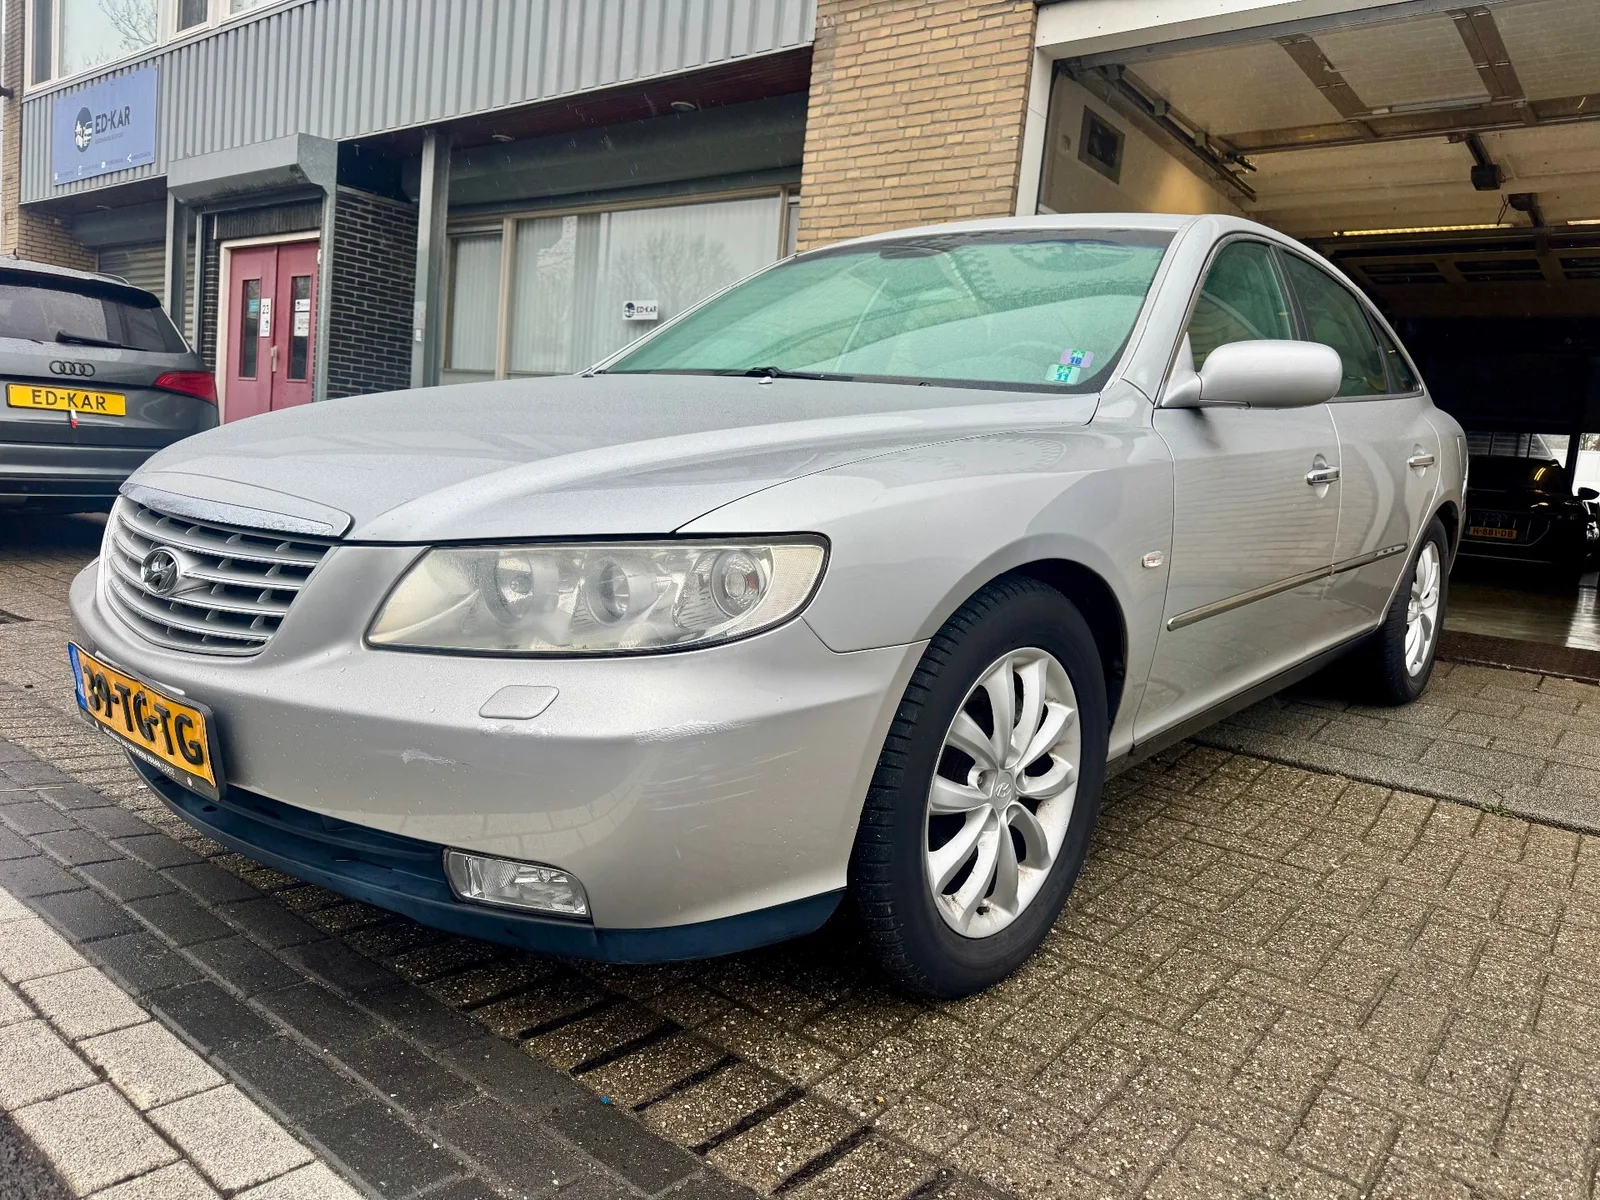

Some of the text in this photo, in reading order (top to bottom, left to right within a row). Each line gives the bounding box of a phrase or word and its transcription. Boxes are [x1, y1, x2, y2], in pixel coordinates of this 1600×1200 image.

[95, 105, 131, 134] ED-KAR
[636, 305, 657, 314] ED-KAR
[31, 388, 108, 411] ED-KAR
[83, 664, 204, 766] 39-TG-TG
